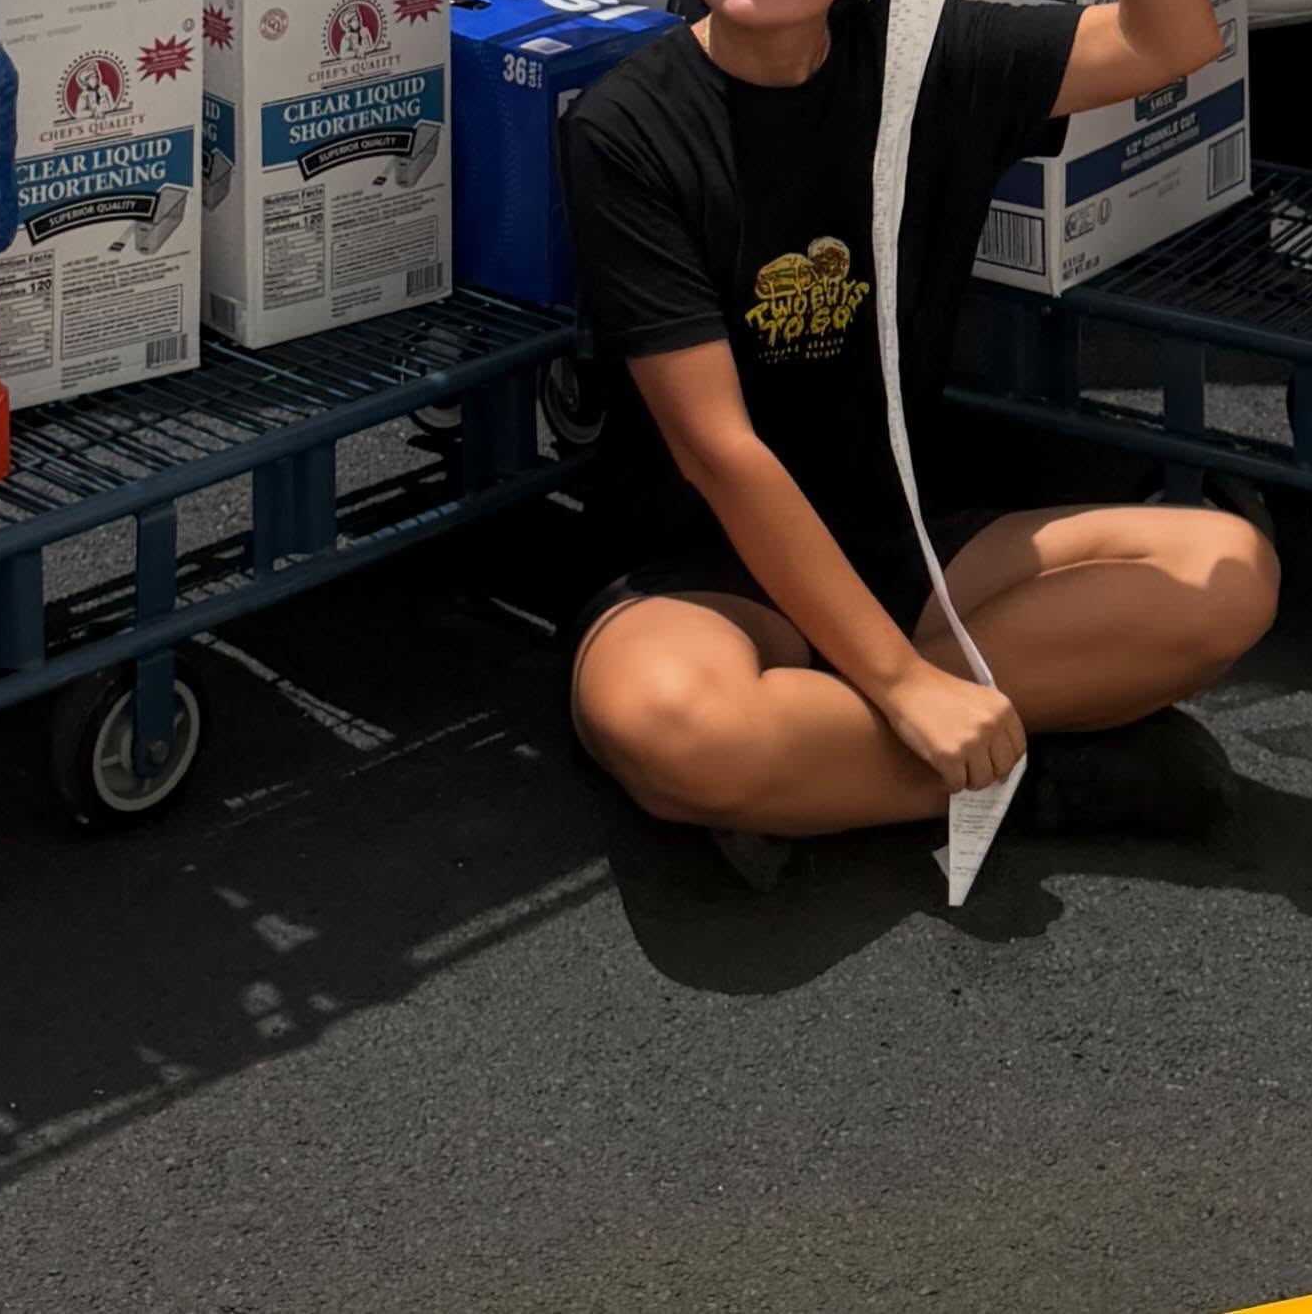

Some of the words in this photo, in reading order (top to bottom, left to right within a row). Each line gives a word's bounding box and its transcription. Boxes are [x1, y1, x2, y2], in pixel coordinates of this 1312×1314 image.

[351, 54, 402, 74] QUALITY
[503, 53, 527, 85] 36
[283, 94, 351, 122] CLEAR
[354, 76, 426, 108] LIQUID
[88, 114, 146, 137] QUALITY
[289, 99, 421, 145] SHORTENING
[17, 157, 86, 185] CLEAR
[93, 138, 172, 170] LIQUID
[318, 142, 359, 164] SUPERIOR
[360, 136, 396, 150] QUALITY
[17, 161, 167, 206] SHORTENING
[49, 205, 95, 227] SUPERIOR
[96, 201, 136, 213] QUALITY
[303, 214, 324, 227] 120
[31, 279, 52, 293] 120
